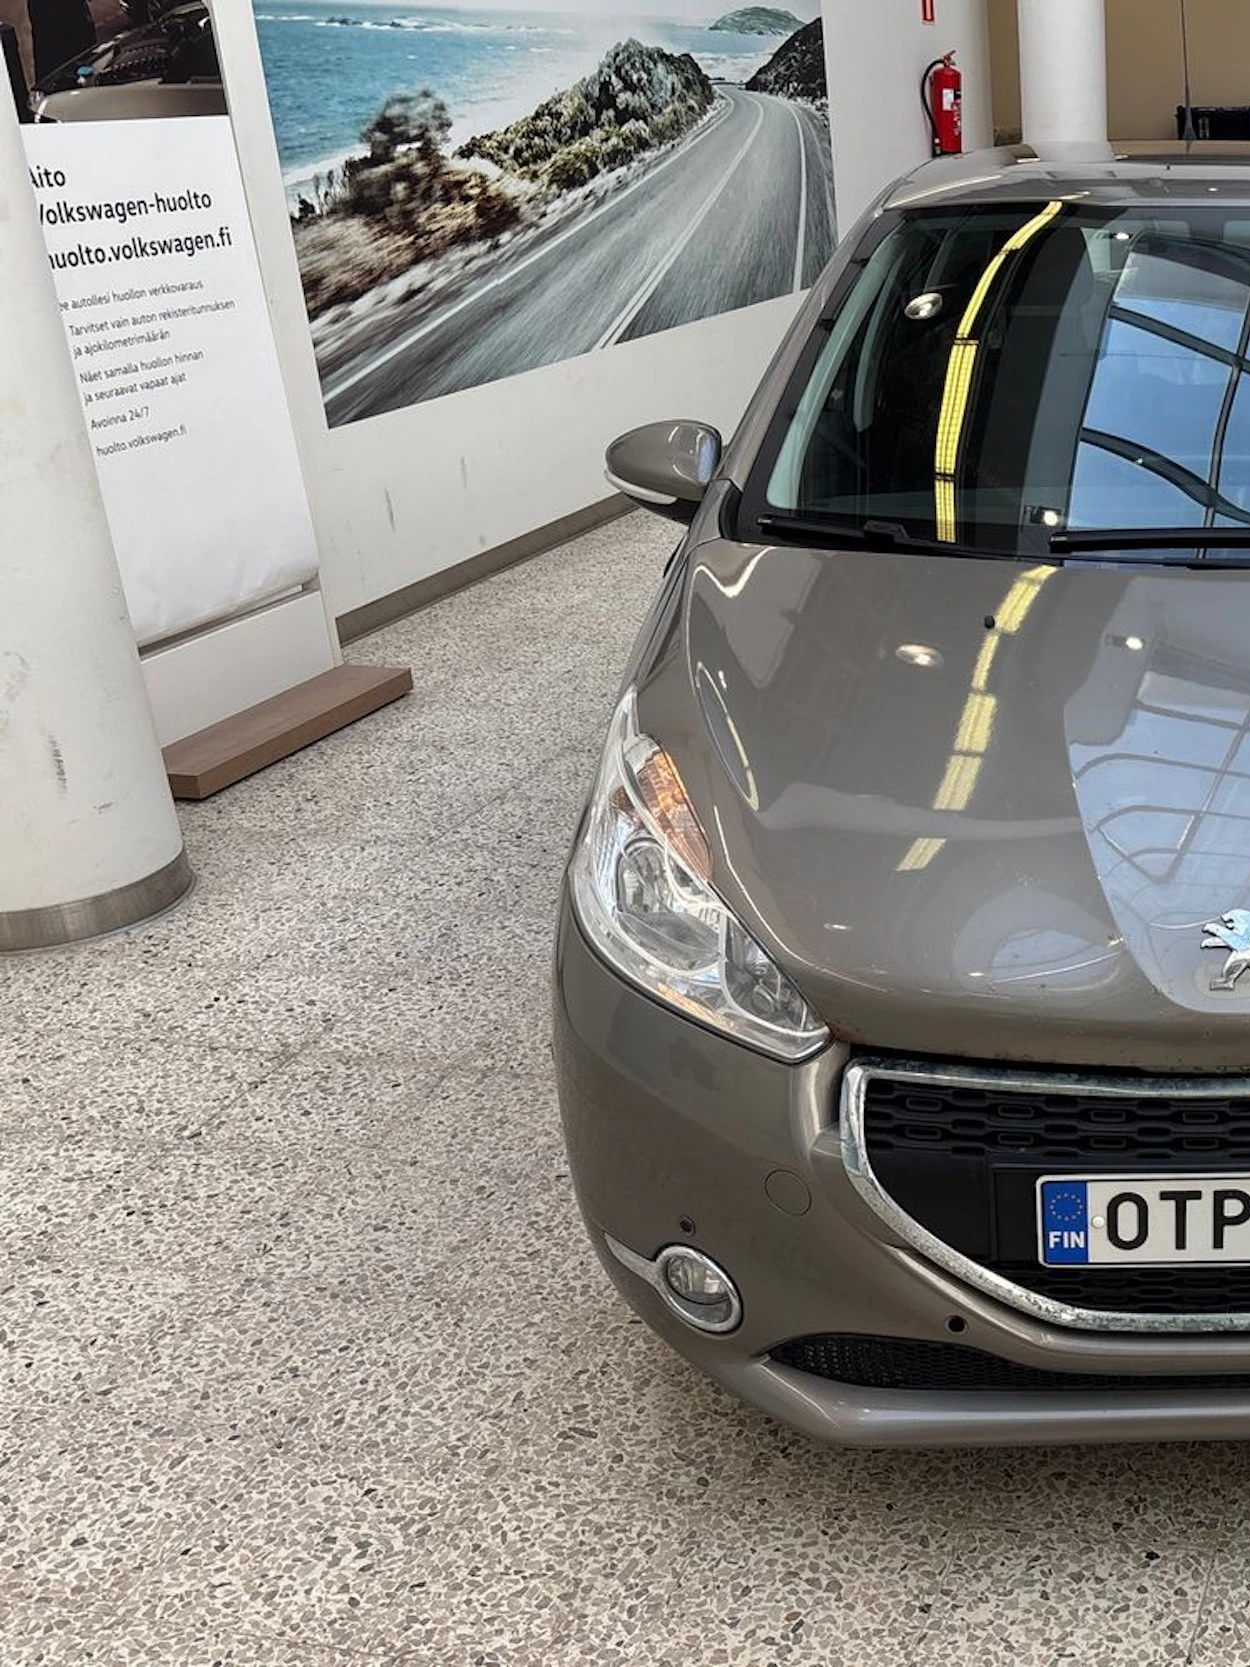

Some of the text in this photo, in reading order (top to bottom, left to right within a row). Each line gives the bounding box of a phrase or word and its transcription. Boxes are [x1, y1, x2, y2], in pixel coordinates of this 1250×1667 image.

[68, 321, 110, 336] Tarvitset
[110, 317, 131, 329] vain
[91, 406, 149, 430] Avoinna 24/7
[96, 424, 187, 456] huolto.volkswagen.fi
[1049, 1231, 1085, 1248] FIN
